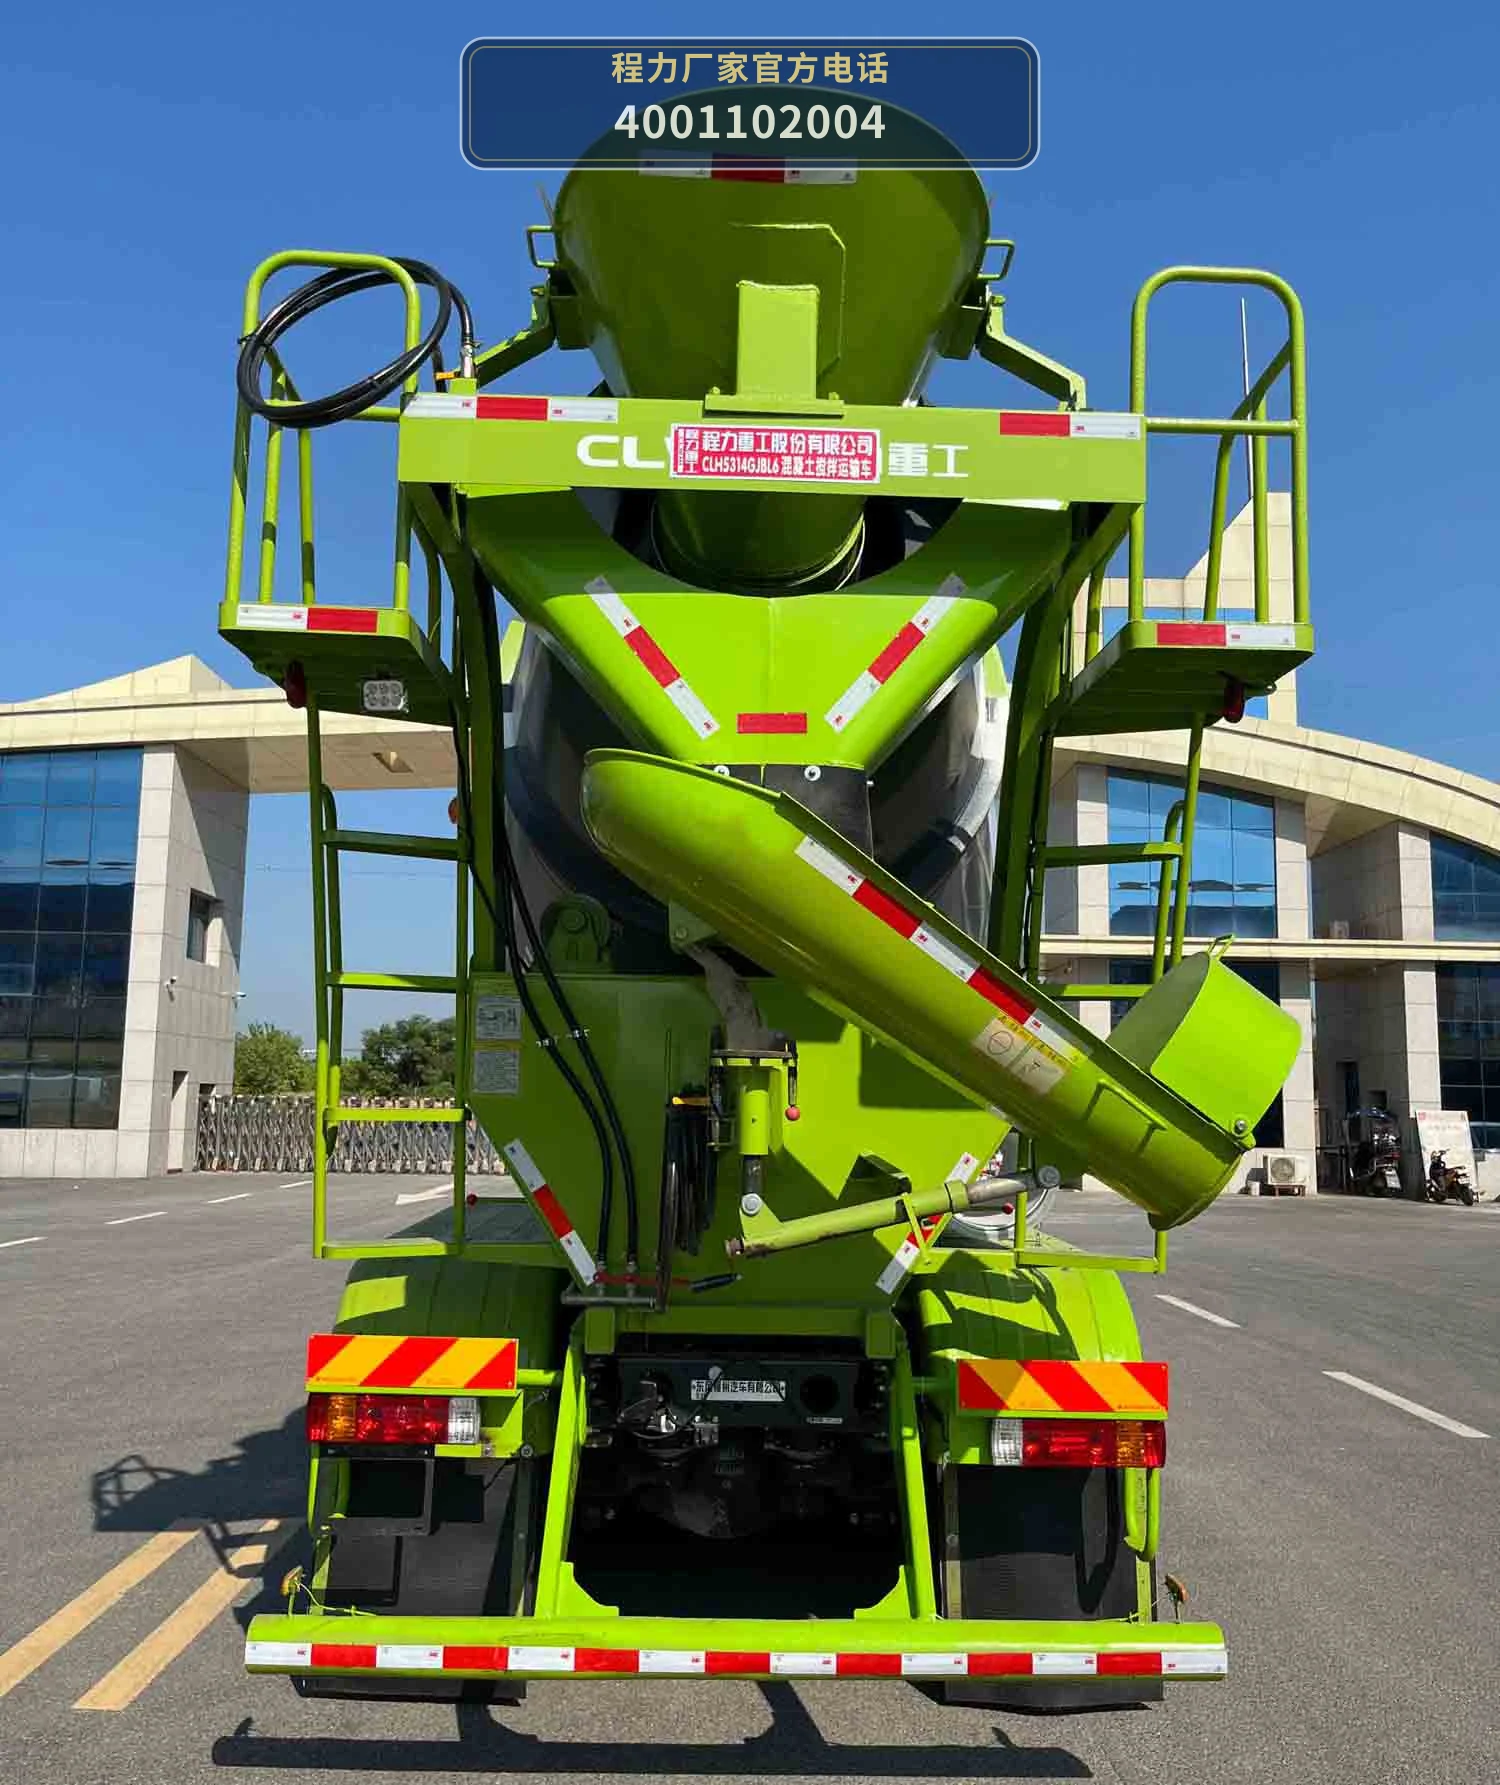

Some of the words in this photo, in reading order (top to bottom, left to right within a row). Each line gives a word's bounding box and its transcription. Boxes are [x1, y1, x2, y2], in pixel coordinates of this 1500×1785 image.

[577, 434, 671, 469] CL
[881, 442, 969, 478] 重工
[702, 431, 873, 456] 程力重工股份有限公司
[702, 456, 780, 474] CLH5314GJBL6
